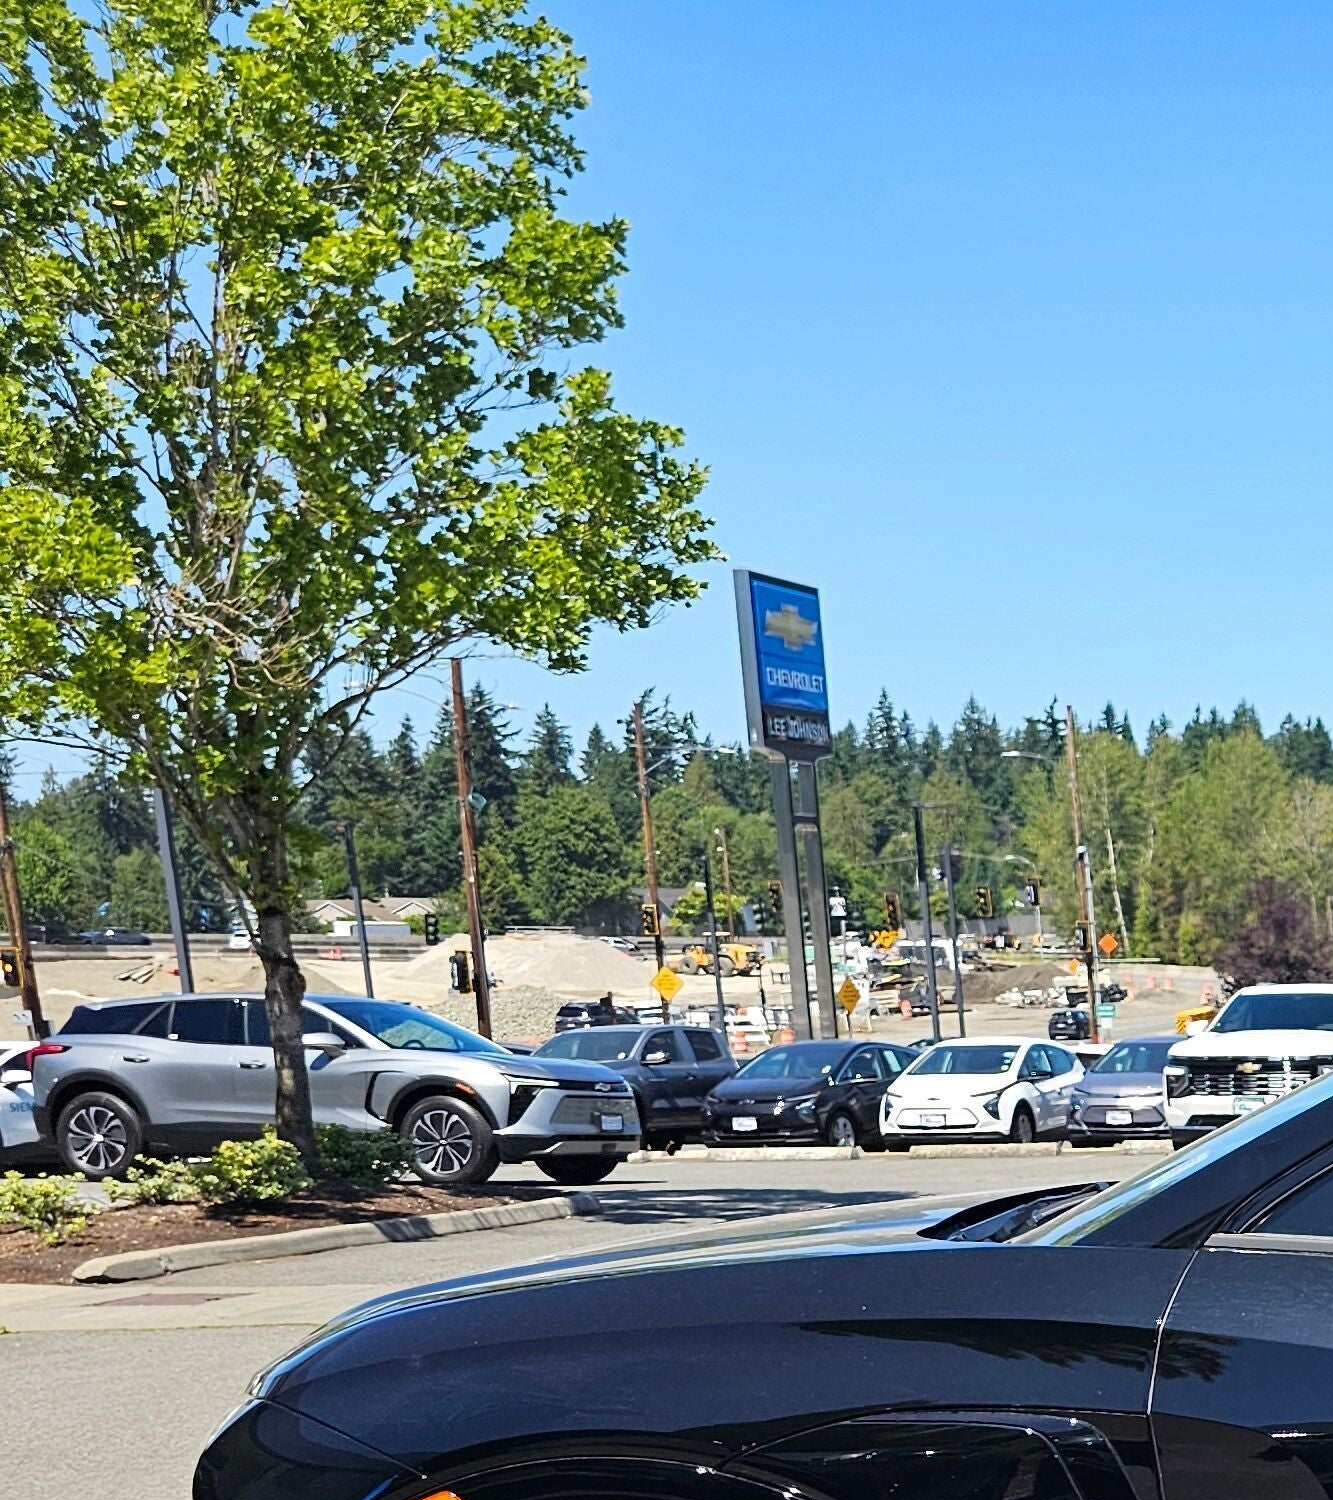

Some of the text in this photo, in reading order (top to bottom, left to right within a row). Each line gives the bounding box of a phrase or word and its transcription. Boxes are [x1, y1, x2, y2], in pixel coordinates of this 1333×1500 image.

[766, 666, 824, 693] CHEVROLET
[769, 717, 829, 742] LEE JOHNSON
